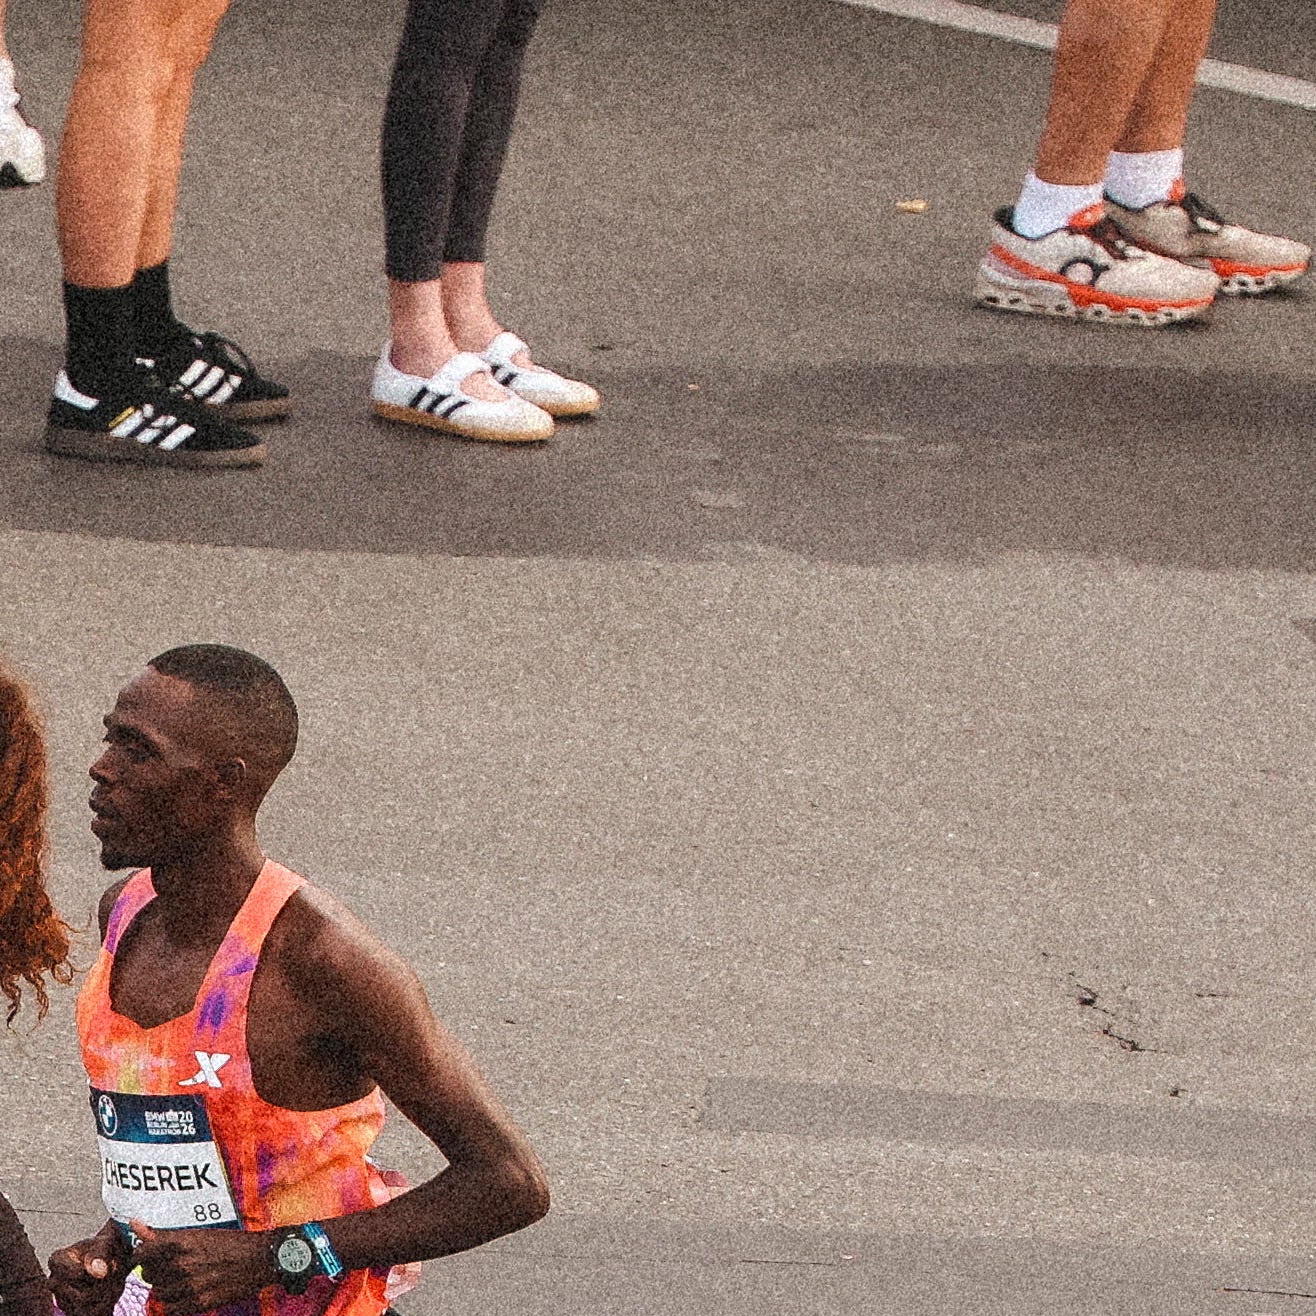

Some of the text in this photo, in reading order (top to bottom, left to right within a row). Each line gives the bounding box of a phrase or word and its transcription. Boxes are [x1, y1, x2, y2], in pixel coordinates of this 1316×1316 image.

[178, 1110, 194, 1123] 20
[180, 1122, 196, 1136] 26
[105, 1157, 218, 1191] CHESEREK
[193, 1202, 222, 1222] 88
